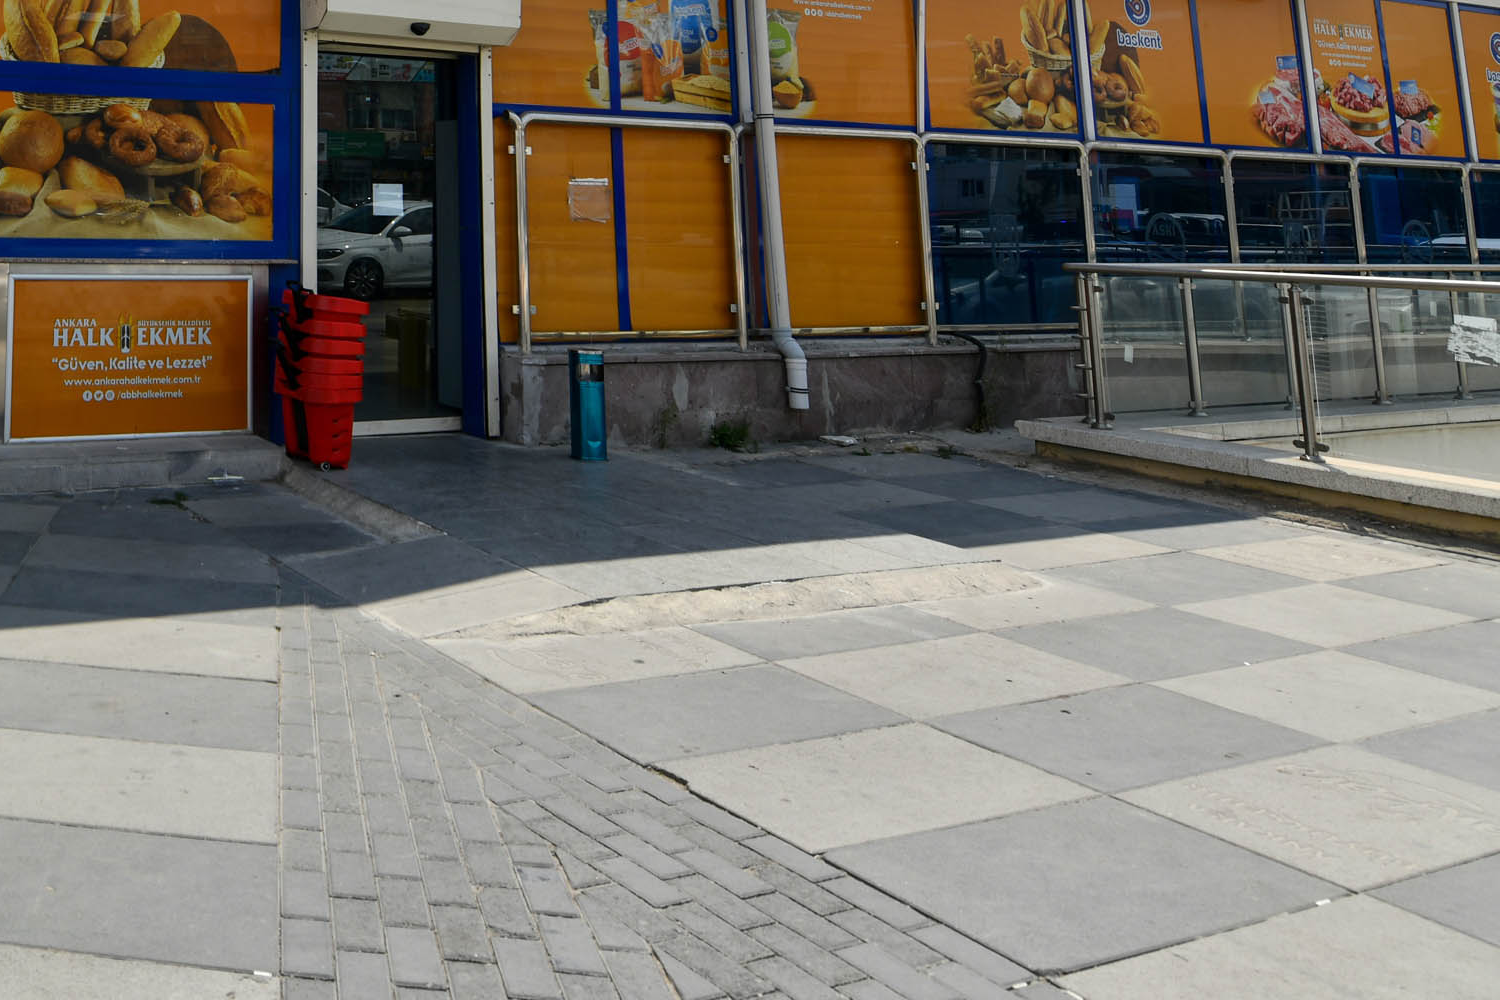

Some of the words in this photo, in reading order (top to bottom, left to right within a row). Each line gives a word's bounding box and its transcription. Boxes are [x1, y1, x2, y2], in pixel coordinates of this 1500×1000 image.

[1313, 23, 1337, 35] HALK
[1344, 26, 1373, 40] EKMEK
[54, 319, 97, 327] ANKARA
[53, 327, 115, 347] HALK
[137, 327, 212, 346] EKMEK
[109, 356, 147, 370] Kalite
[147, 359, 164, 369] ve
